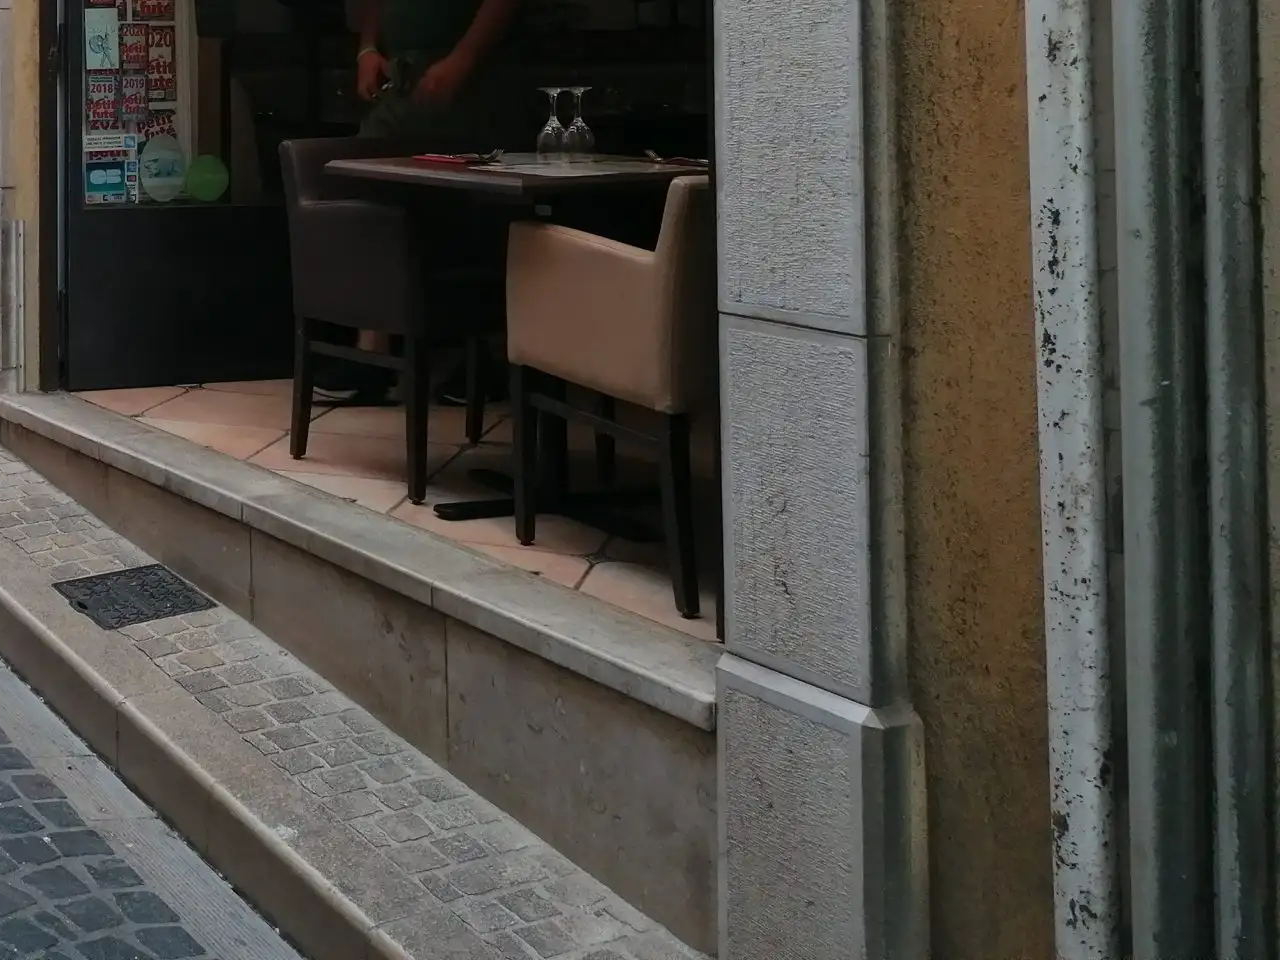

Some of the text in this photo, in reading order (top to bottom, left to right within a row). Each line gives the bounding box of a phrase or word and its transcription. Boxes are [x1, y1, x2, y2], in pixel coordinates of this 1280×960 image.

[148, 31, 172, 47] 020
[91, 83, 113, 93] 2018
[124, 78, 145, 88] 2019
